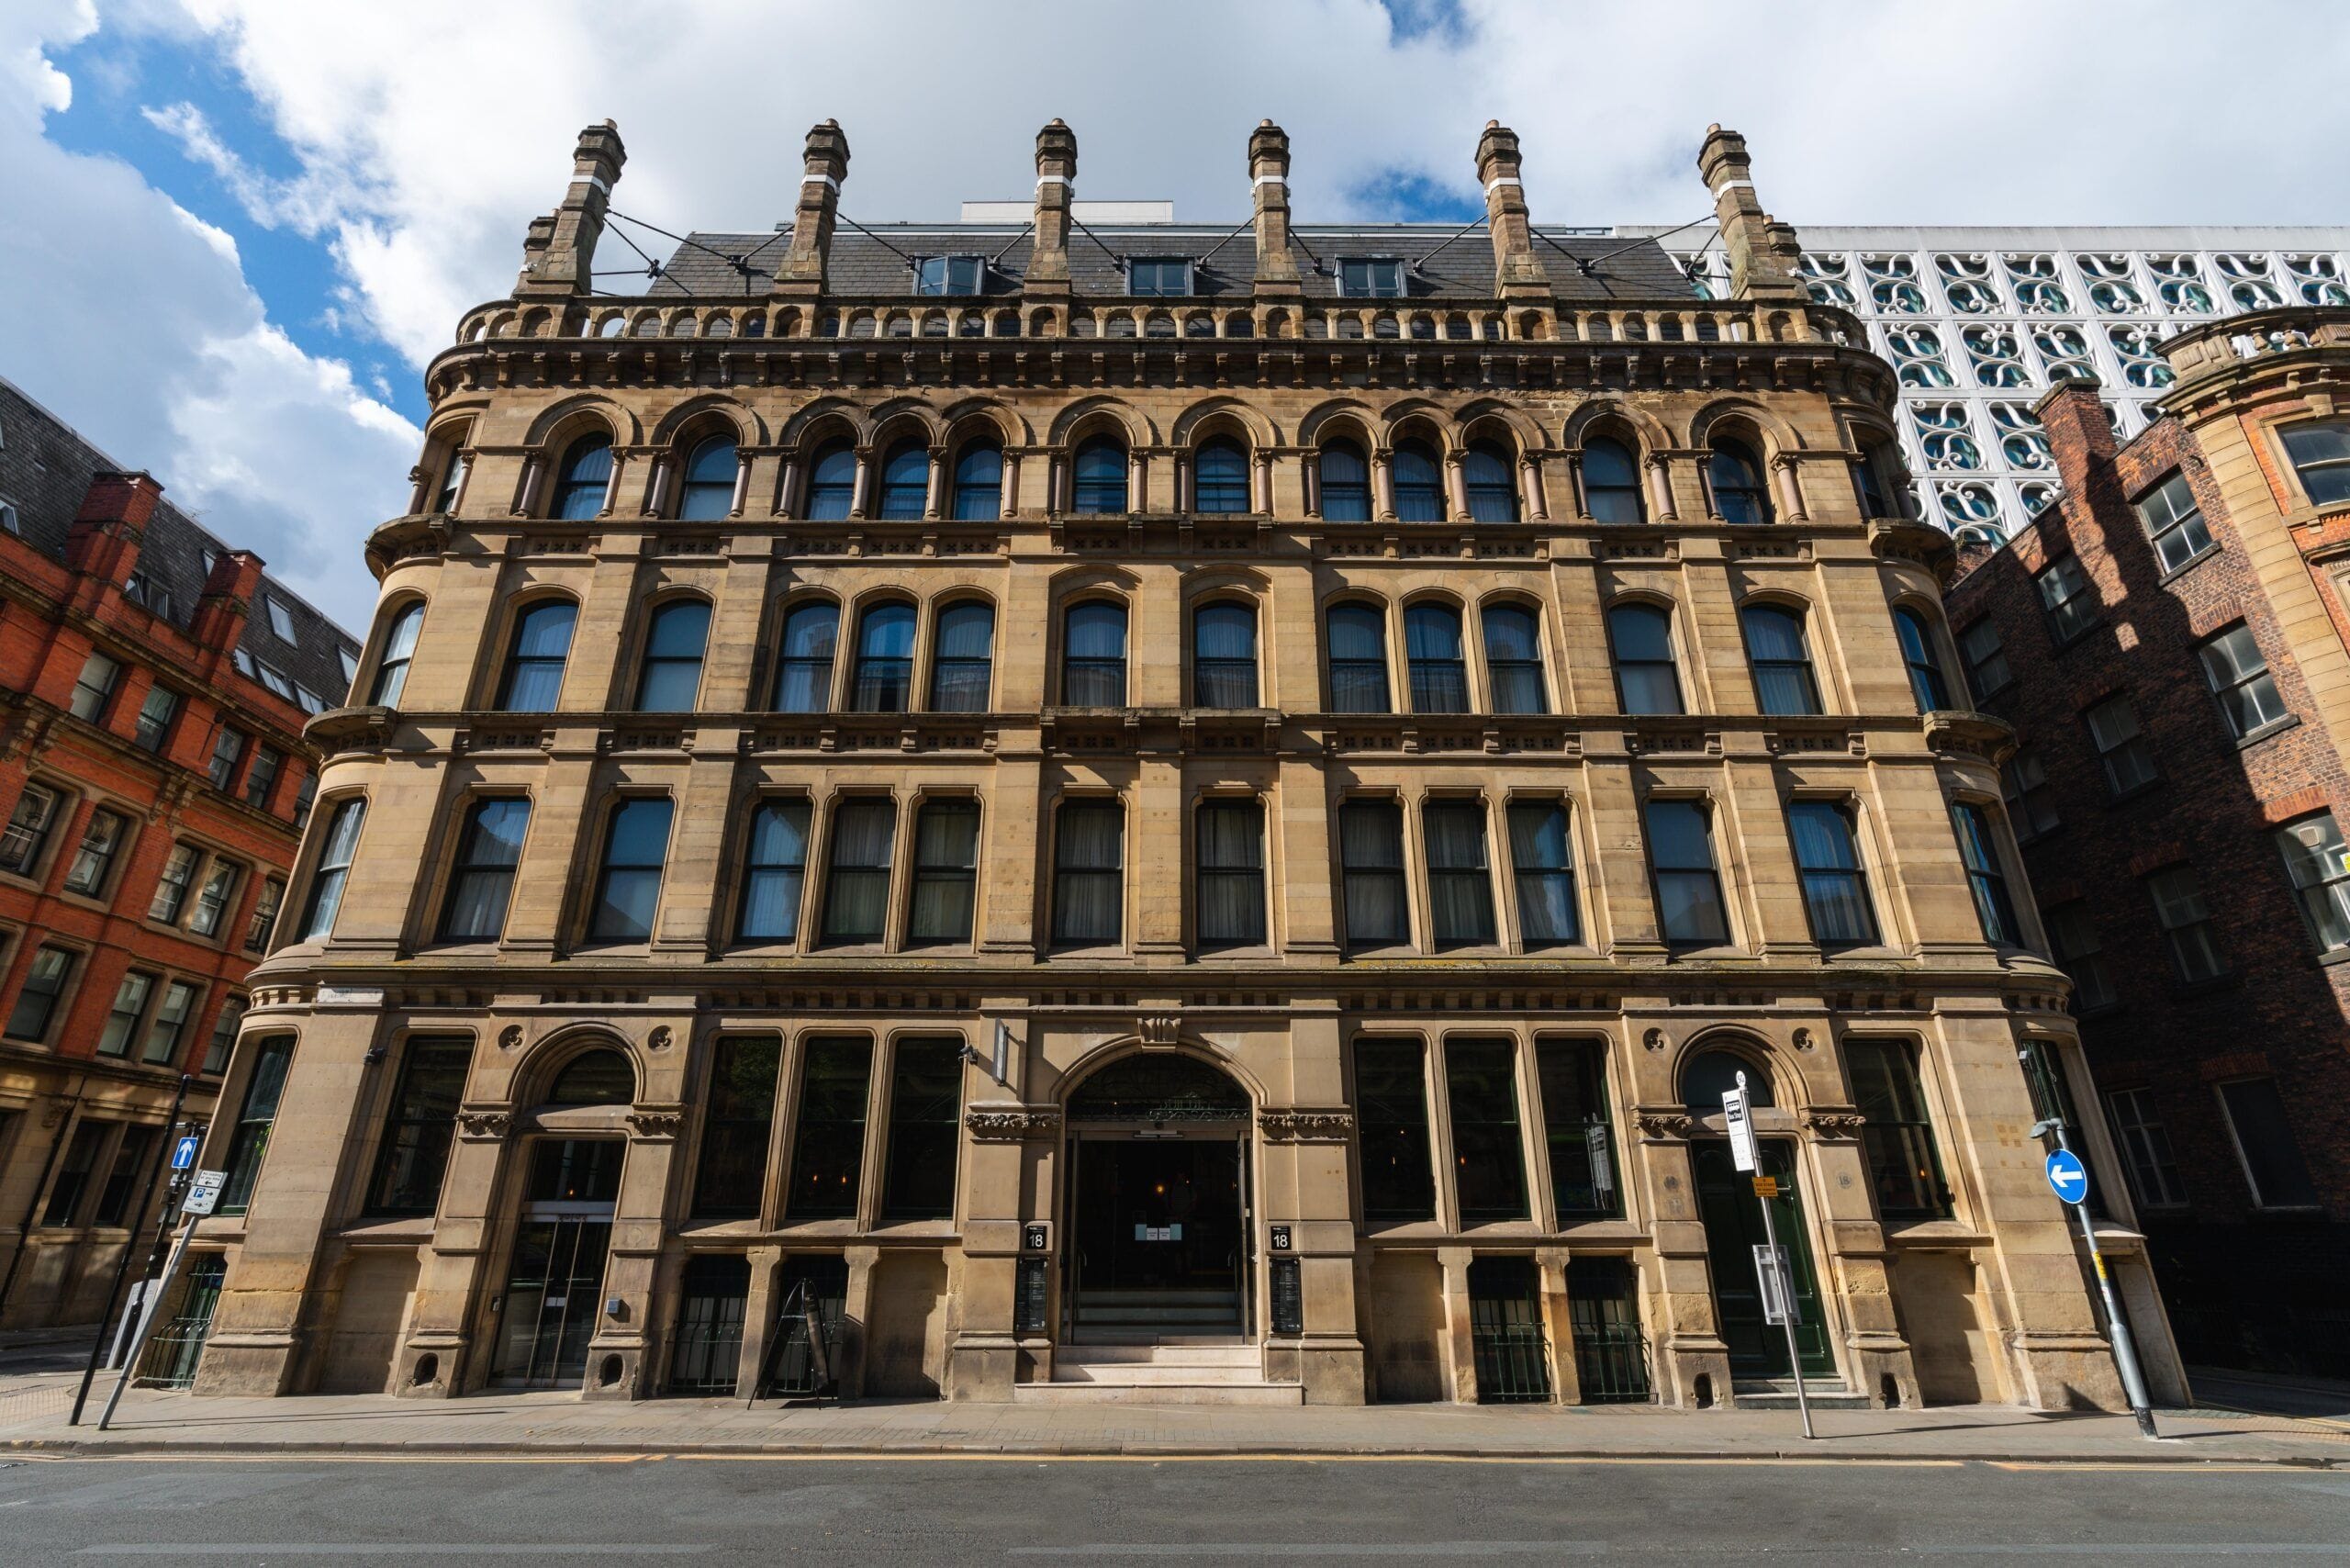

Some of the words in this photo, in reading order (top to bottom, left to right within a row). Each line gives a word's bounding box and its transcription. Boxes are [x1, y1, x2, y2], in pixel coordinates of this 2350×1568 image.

[195, 1188, 204, 1197] P
[1029, 1234, 1043, 1248] 18
[1273, 1234, 1288, 1248] 18
